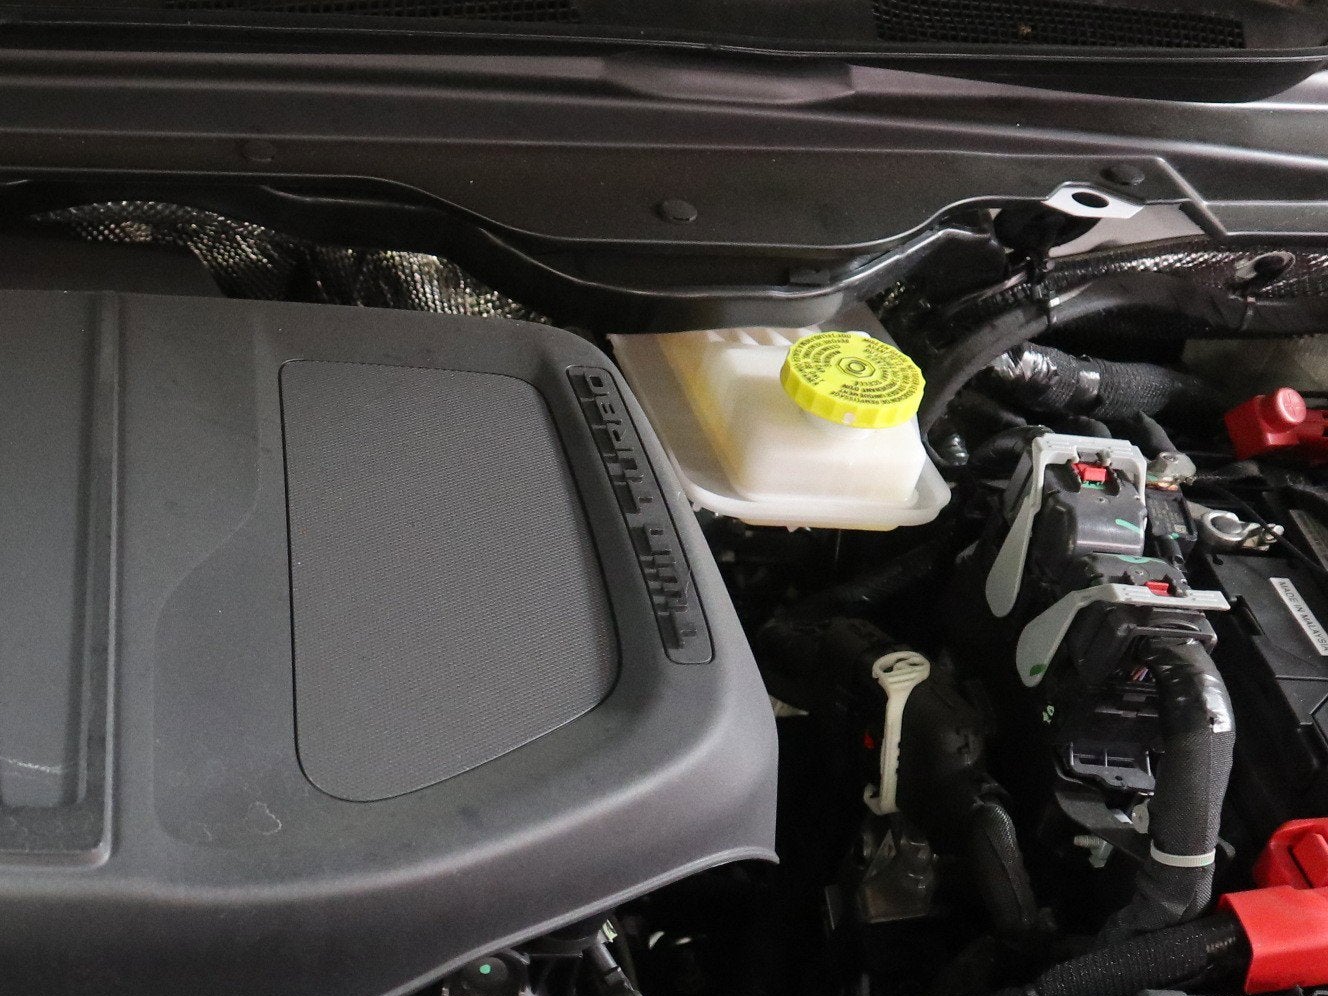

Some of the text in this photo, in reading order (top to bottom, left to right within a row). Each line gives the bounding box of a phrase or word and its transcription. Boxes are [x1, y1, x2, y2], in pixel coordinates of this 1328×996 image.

[572, 374, 654, 515] TURBO
[1278, 579, 1297, 604] MADE
[1300, 611, 1328, 652] MALAYSIA
